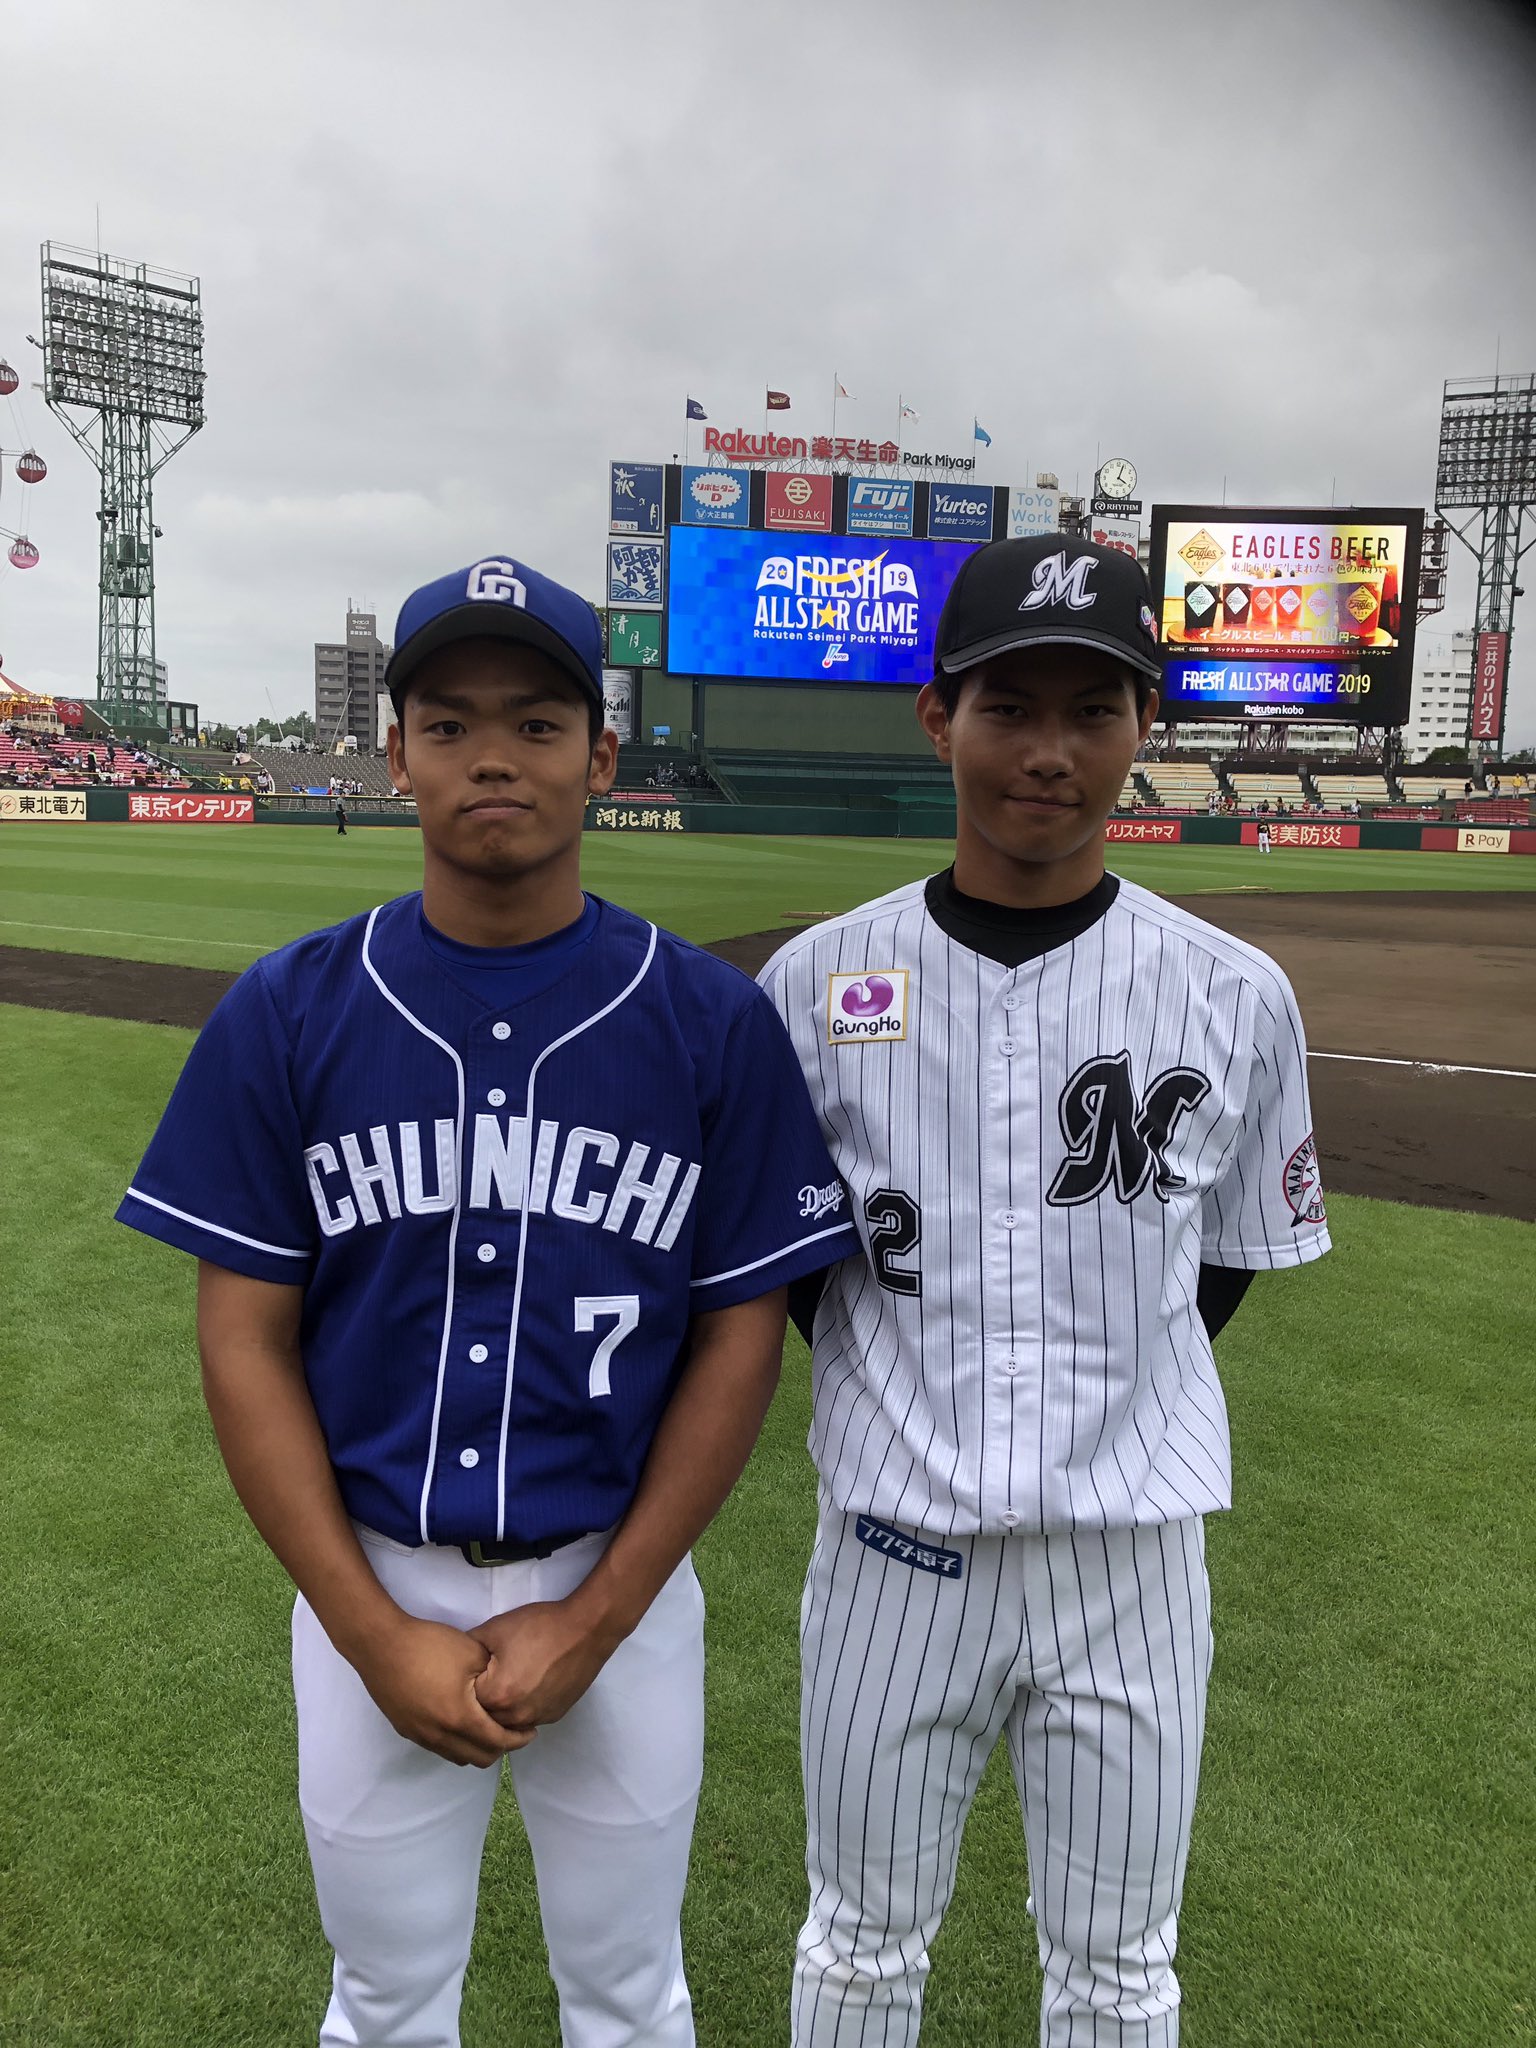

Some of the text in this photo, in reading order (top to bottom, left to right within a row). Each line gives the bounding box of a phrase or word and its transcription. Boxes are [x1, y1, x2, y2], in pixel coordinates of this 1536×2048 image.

[705, 427, 976, 470] Rakuten 楽天生命 Park Miyagi
[710, 493, 723, 502] D
[853, 482, 910, 511] Fuji
[934, 494, 988, 516] Yurtec
[1017, 492, 1053, 507] ToYo
[1107, 503, 1139, 511] RHYTHM
[770, 508, 825, 520] FUJISAKI
[934, 517, 987, 526] 株式会社 ユアテック
[1011, 509, 1056, 524] Work.
[612, 545, 660, 571] 阿部
[1185, 546, 1217, 560] Eagles
[1231, 534, 1321, 560] EAGLES
[1331, 536, 1390, 561] BEER
[766, 555, 908, 600] 20 FRESH 19
[856, 601, 919, 634] GAME
[611, 613, 659, 664] 清月記
[753, 629, 918, 647] Rakuten Seimei Park Miyagi
[1199, 630, 1284, 642] イーグルスビール
[1182, 669, 1227, 691] FRESH
[1293, 673, 1332, 693] GAME
[1337, 674, 1371, 694] 2019
[1479, 636, 1498, 735] 三井のリハウス
[1244, 704, 1304, 715] Rakuten kobo
[19, 796, 86, 815] 東北電力
[130, 795, 252, 818] 東京インテリア
[596, 807, 684, 831] 河北新報
[1465, 832, 1504, 849] R Pay
[832, 1015, 902, 1036] GungHo
[303, 1113, 702, 1252] CHUNICHI
[864, 1187, 923, 1298] 2
[574, 1295, 640, 1399] 7
